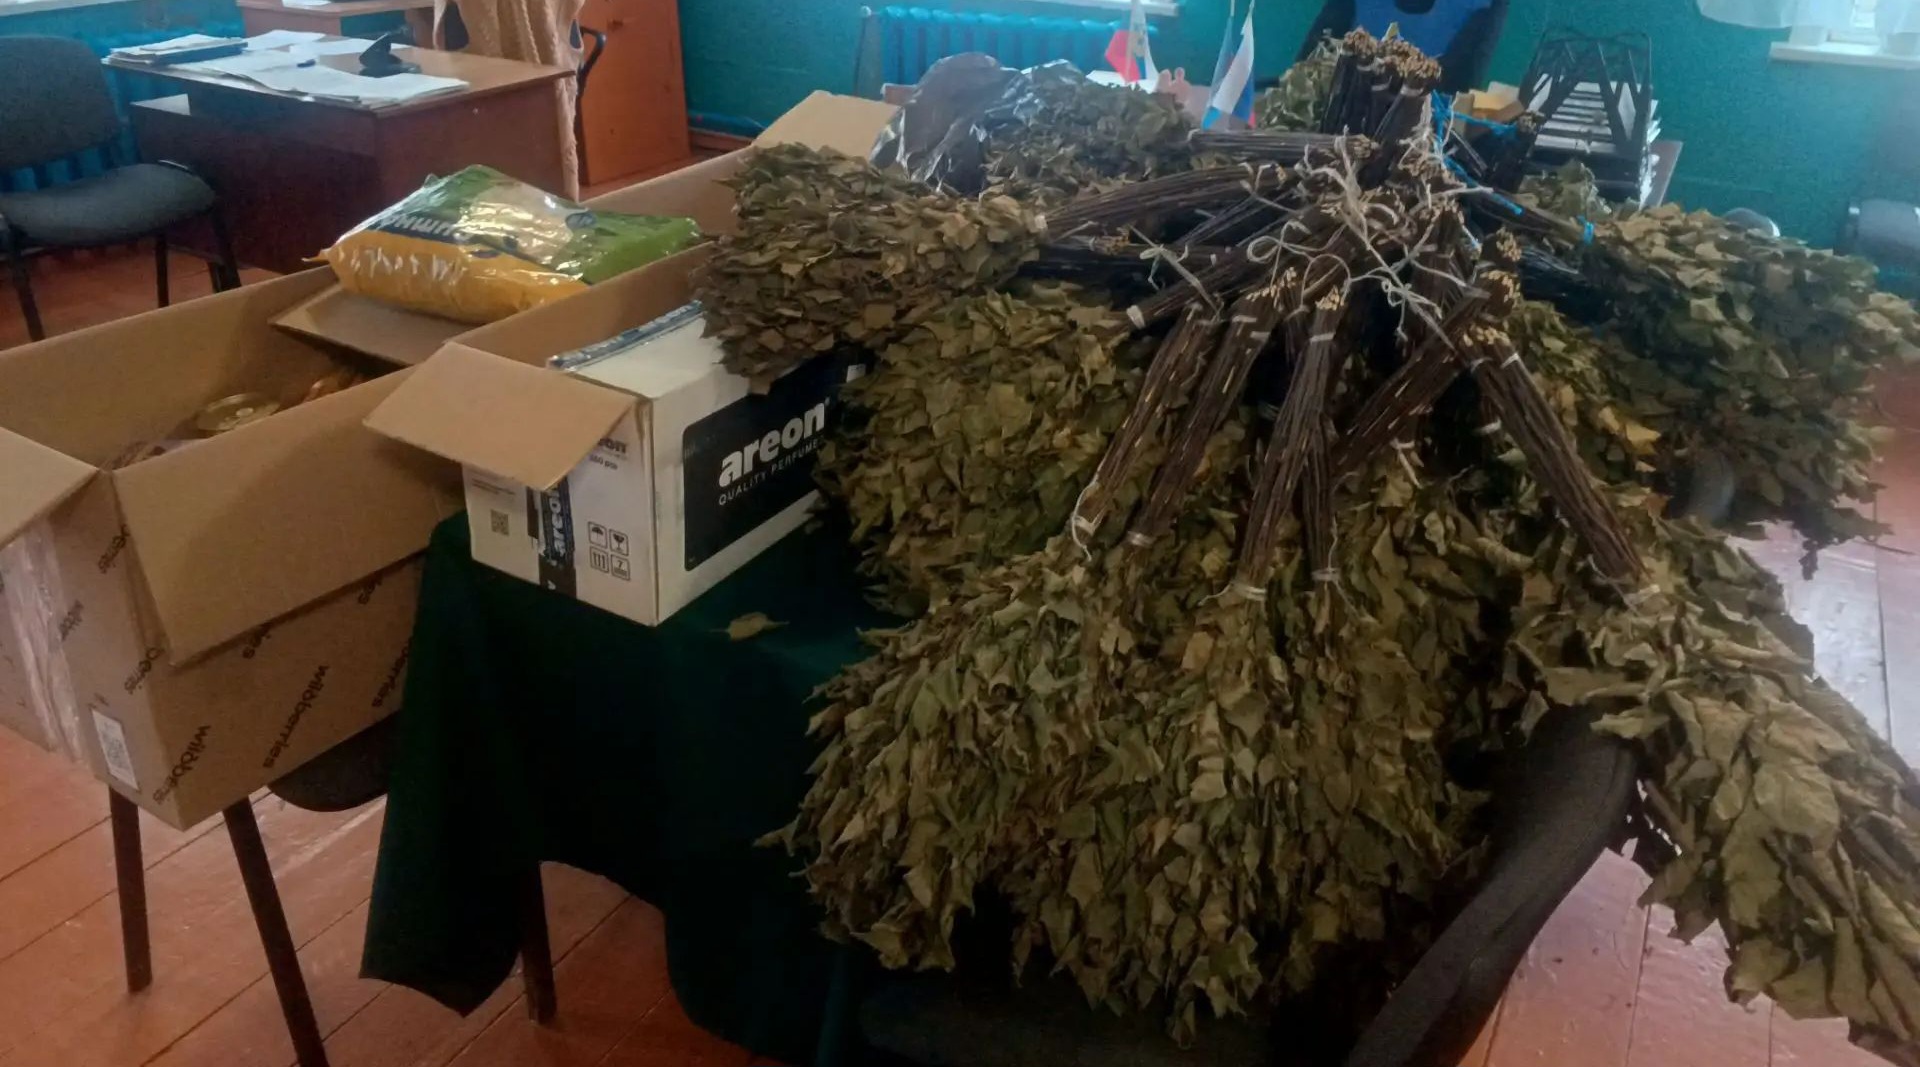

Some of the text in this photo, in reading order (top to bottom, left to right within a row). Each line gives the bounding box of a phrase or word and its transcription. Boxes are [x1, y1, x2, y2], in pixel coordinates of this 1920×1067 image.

[718, 402, 826, 488] areon
[718, 438, 819, 507] QUALITY PERFUME
[263, 665, 331, 769] wildberries
